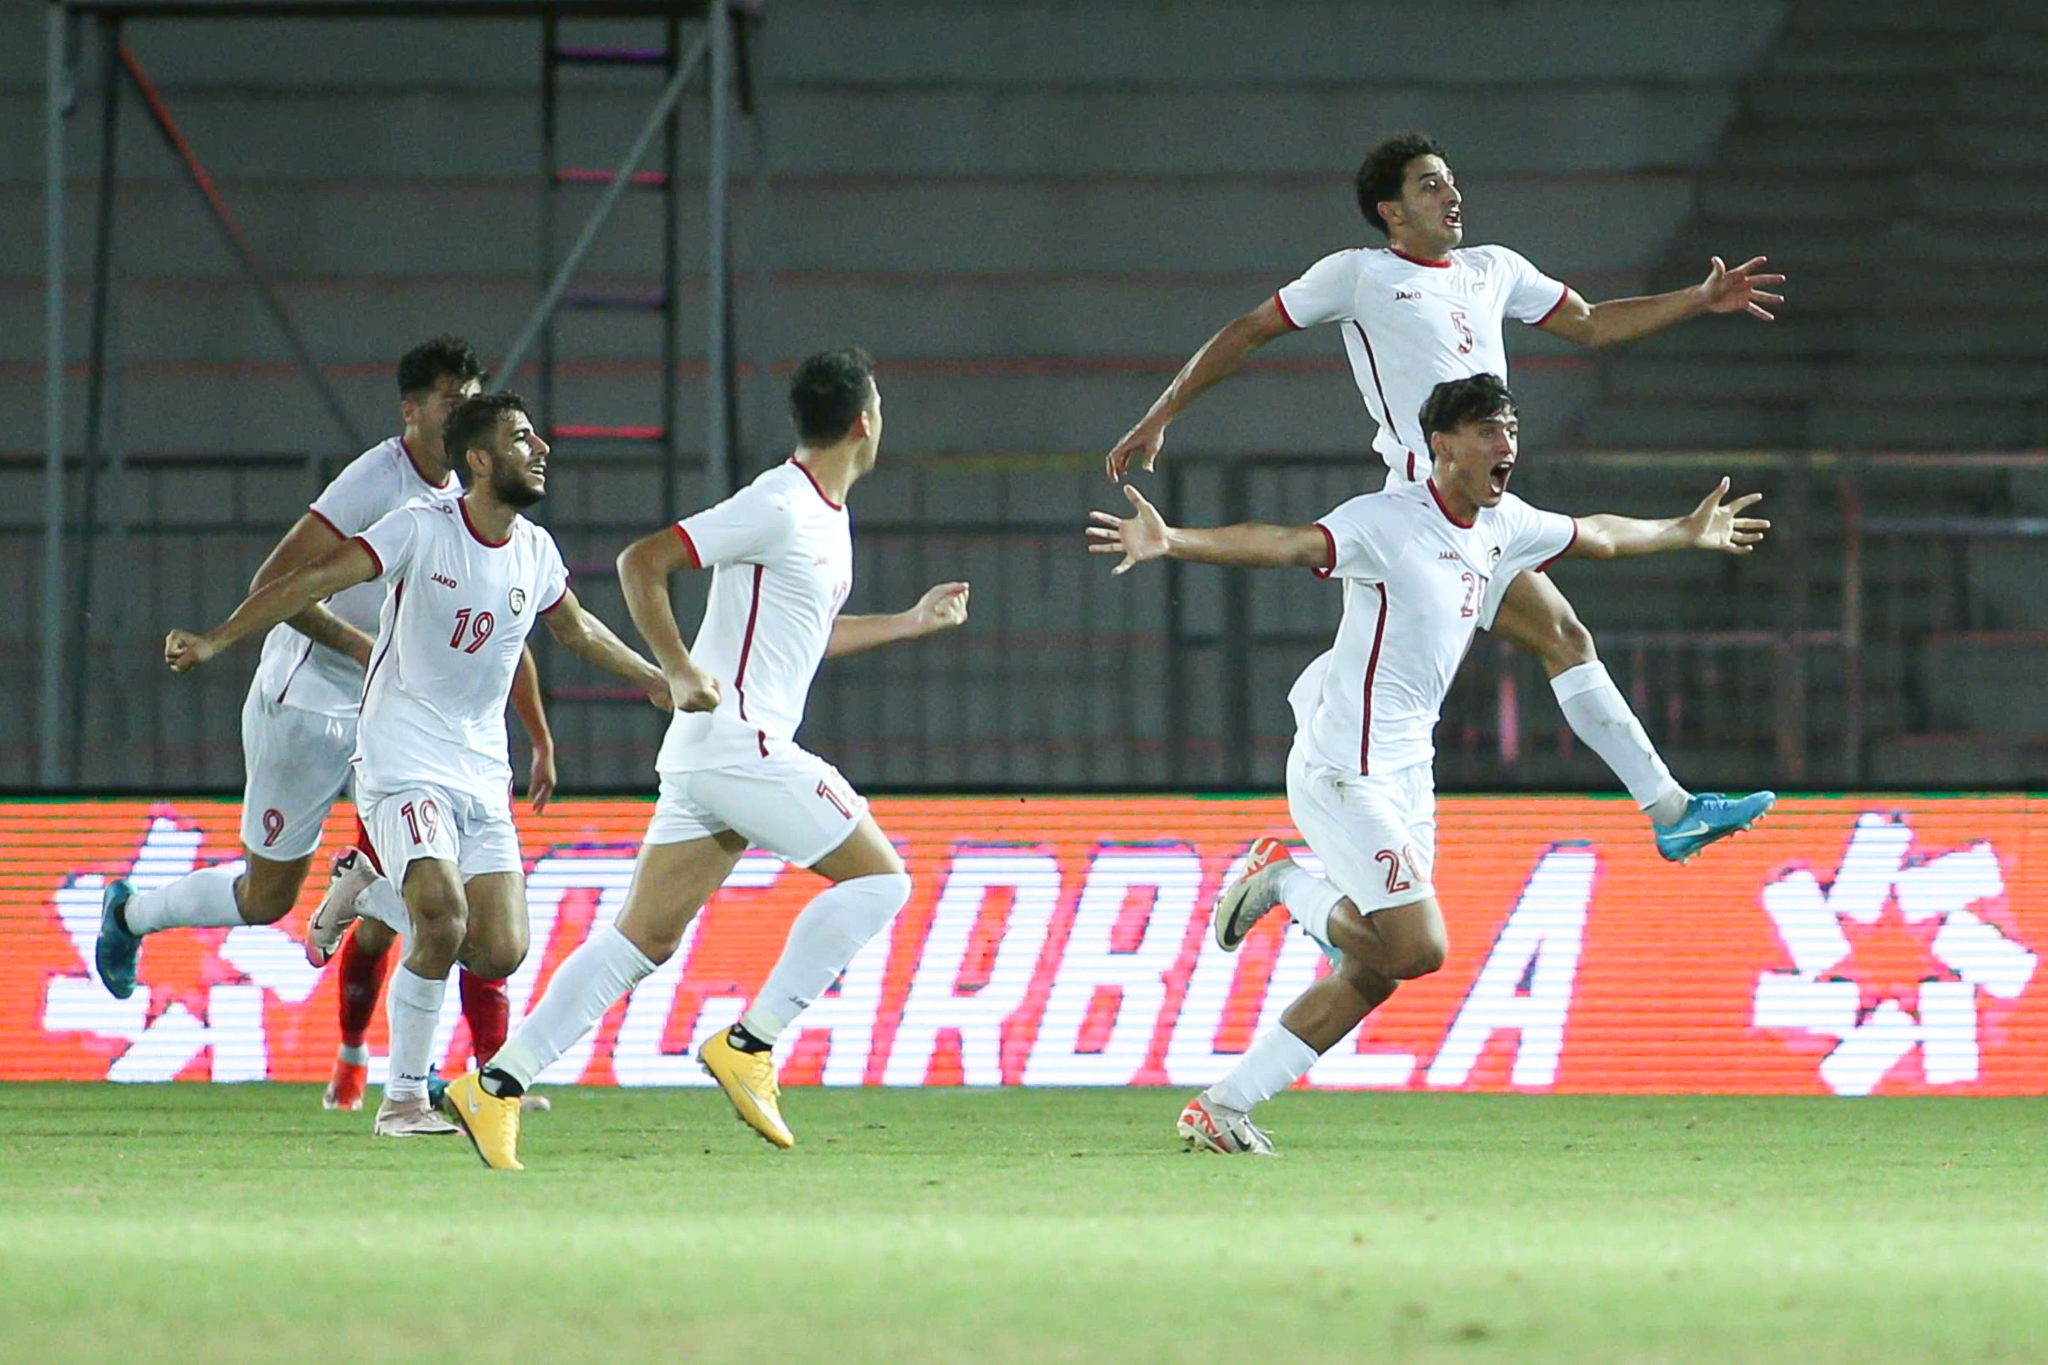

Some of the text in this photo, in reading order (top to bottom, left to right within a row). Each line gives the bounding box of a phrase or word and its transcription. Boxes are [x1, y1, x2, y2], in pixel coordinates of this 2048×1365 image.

[1451, 312, 1473, 354] 5
[431, 572, 458, 589] JAKO
[450, 608, 495, 654] 19
[262, 808, 285, 847] 9
[401, 800, 439, 846] 19
